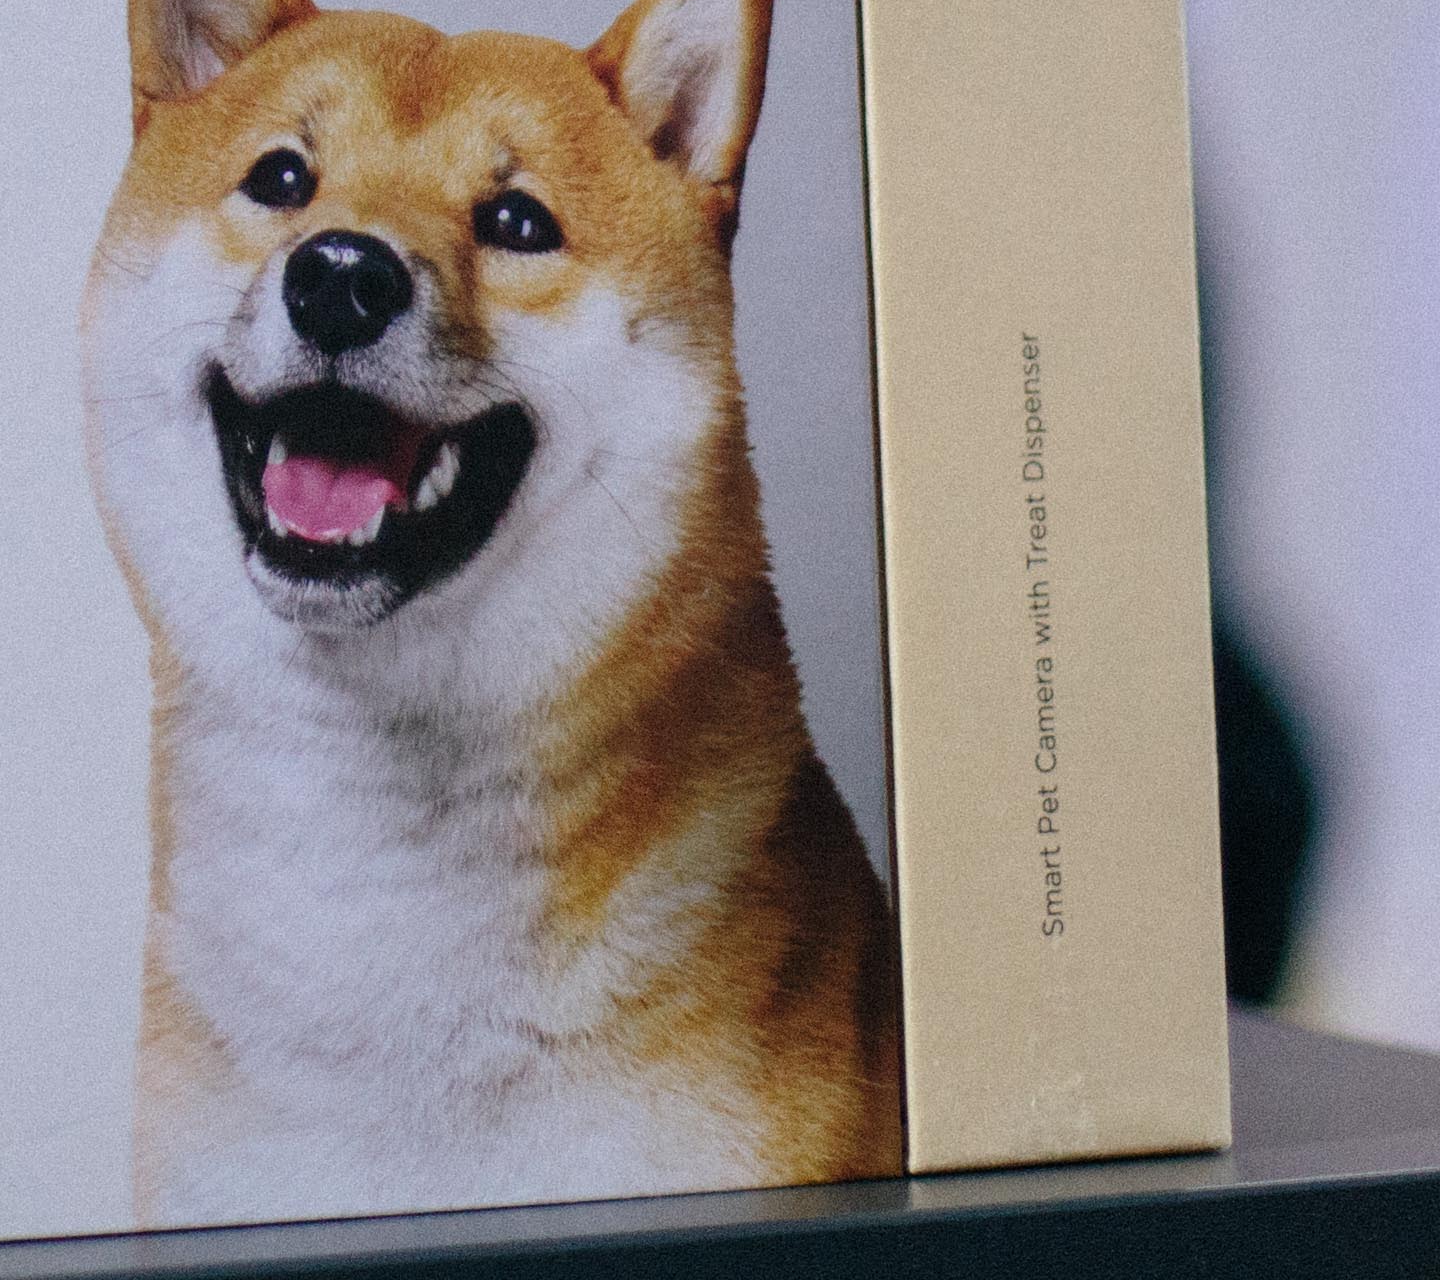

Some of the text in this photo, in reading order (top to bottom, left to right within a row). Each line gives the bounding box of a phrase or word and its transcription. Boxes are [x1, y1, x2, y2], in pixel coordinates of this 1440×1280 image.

[1021, 330, 1065, 938] Smart Pet Camera with Treat Dispenser
